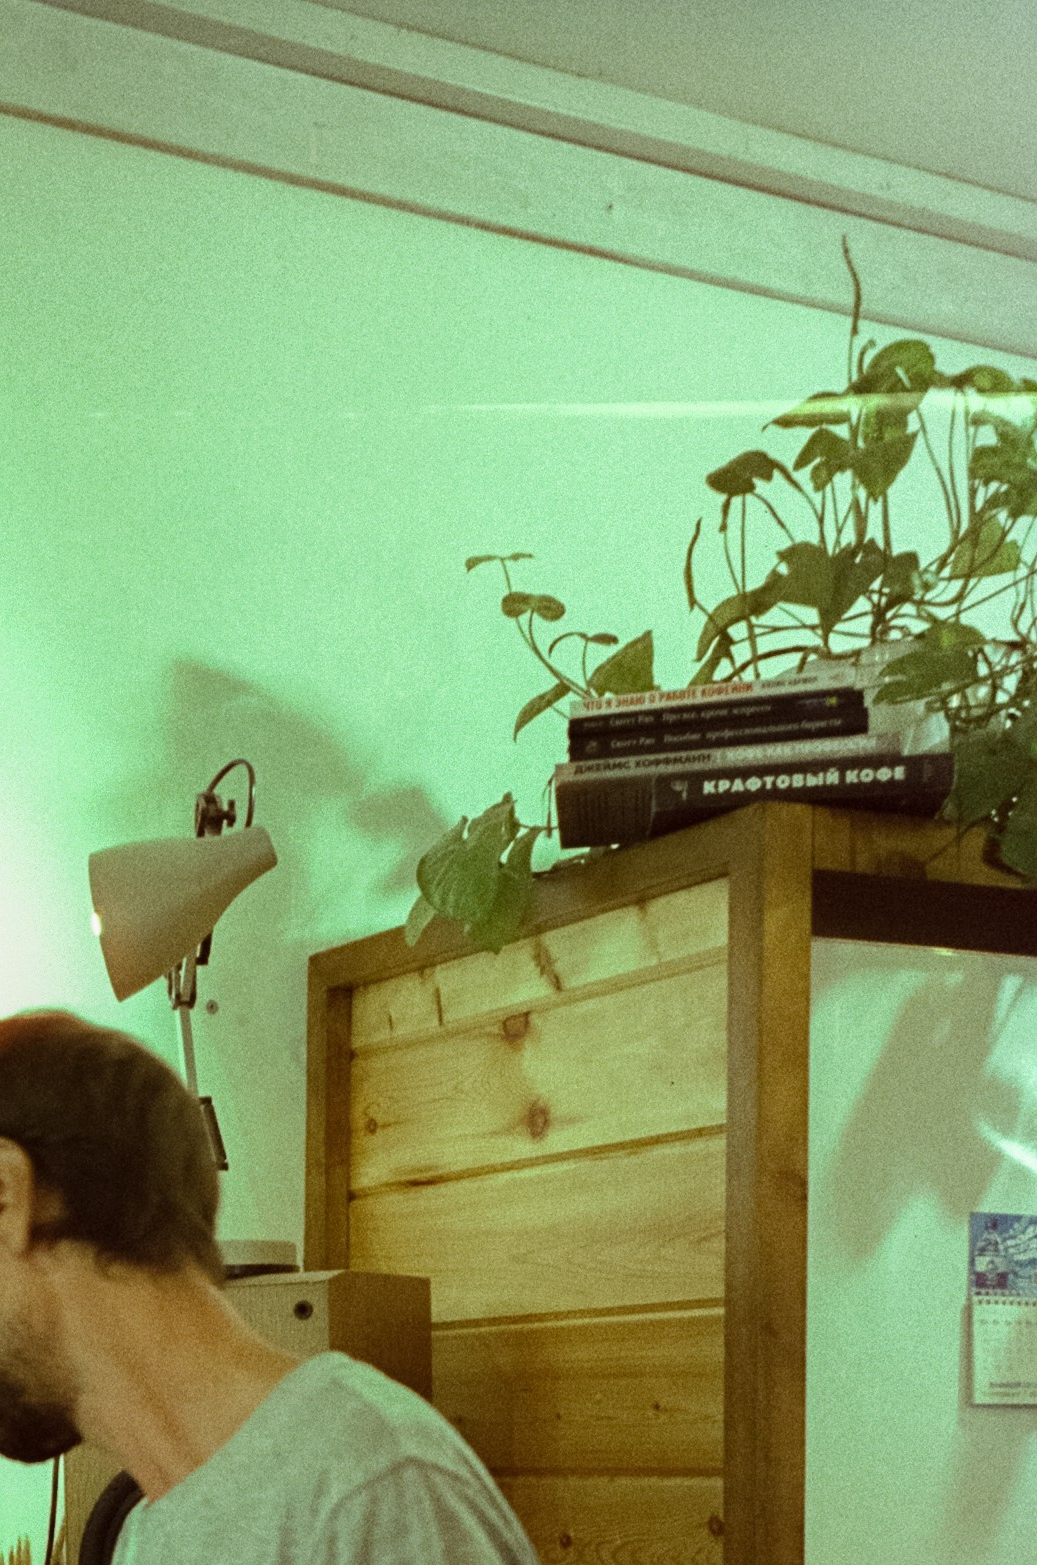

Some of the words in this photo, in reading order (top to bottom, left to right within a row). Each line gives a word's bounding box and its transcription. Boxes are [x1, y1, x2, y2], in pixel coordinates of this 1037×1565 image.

[573, 756, 631, 775] ДЖЕЙМС
[634, 752, 712, 771] ХОФФМАНН
[702, 767, 840, 796] КРАФТОВЫЙ
[845, 764, 907, 786] КОФЕ
